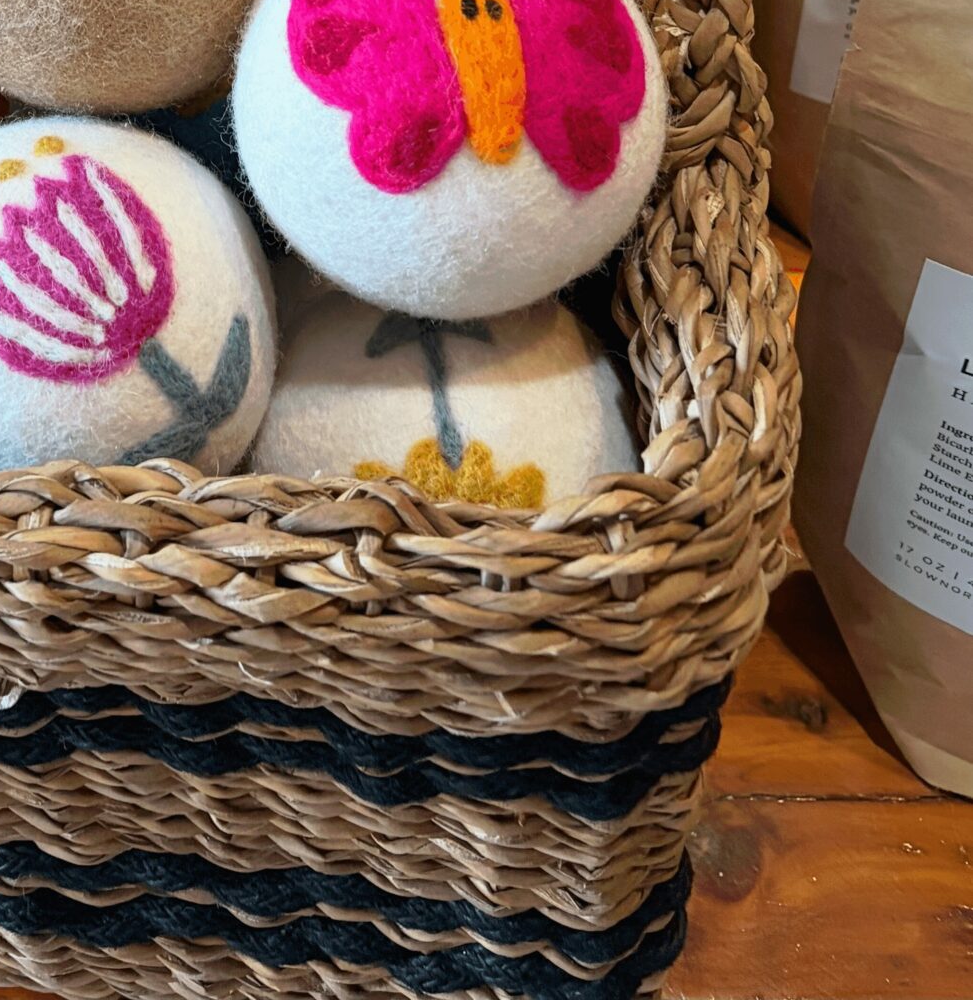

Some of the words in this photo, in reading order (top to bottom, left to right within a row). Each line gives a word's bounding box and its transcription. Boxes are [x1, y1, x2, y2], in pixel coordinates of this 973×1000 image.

[929, 453, 961, 475] Lime
[932, 443, 973, 468] Starch
[913, 493, 944, 512] your
[918, 482, 965, 510] powder
[909, 509, 954, 537] Caution:
[932, 533, 958, 551] Keep
[899, 541, 914, 553] 17
[922, 555, 945, 573] OZ
